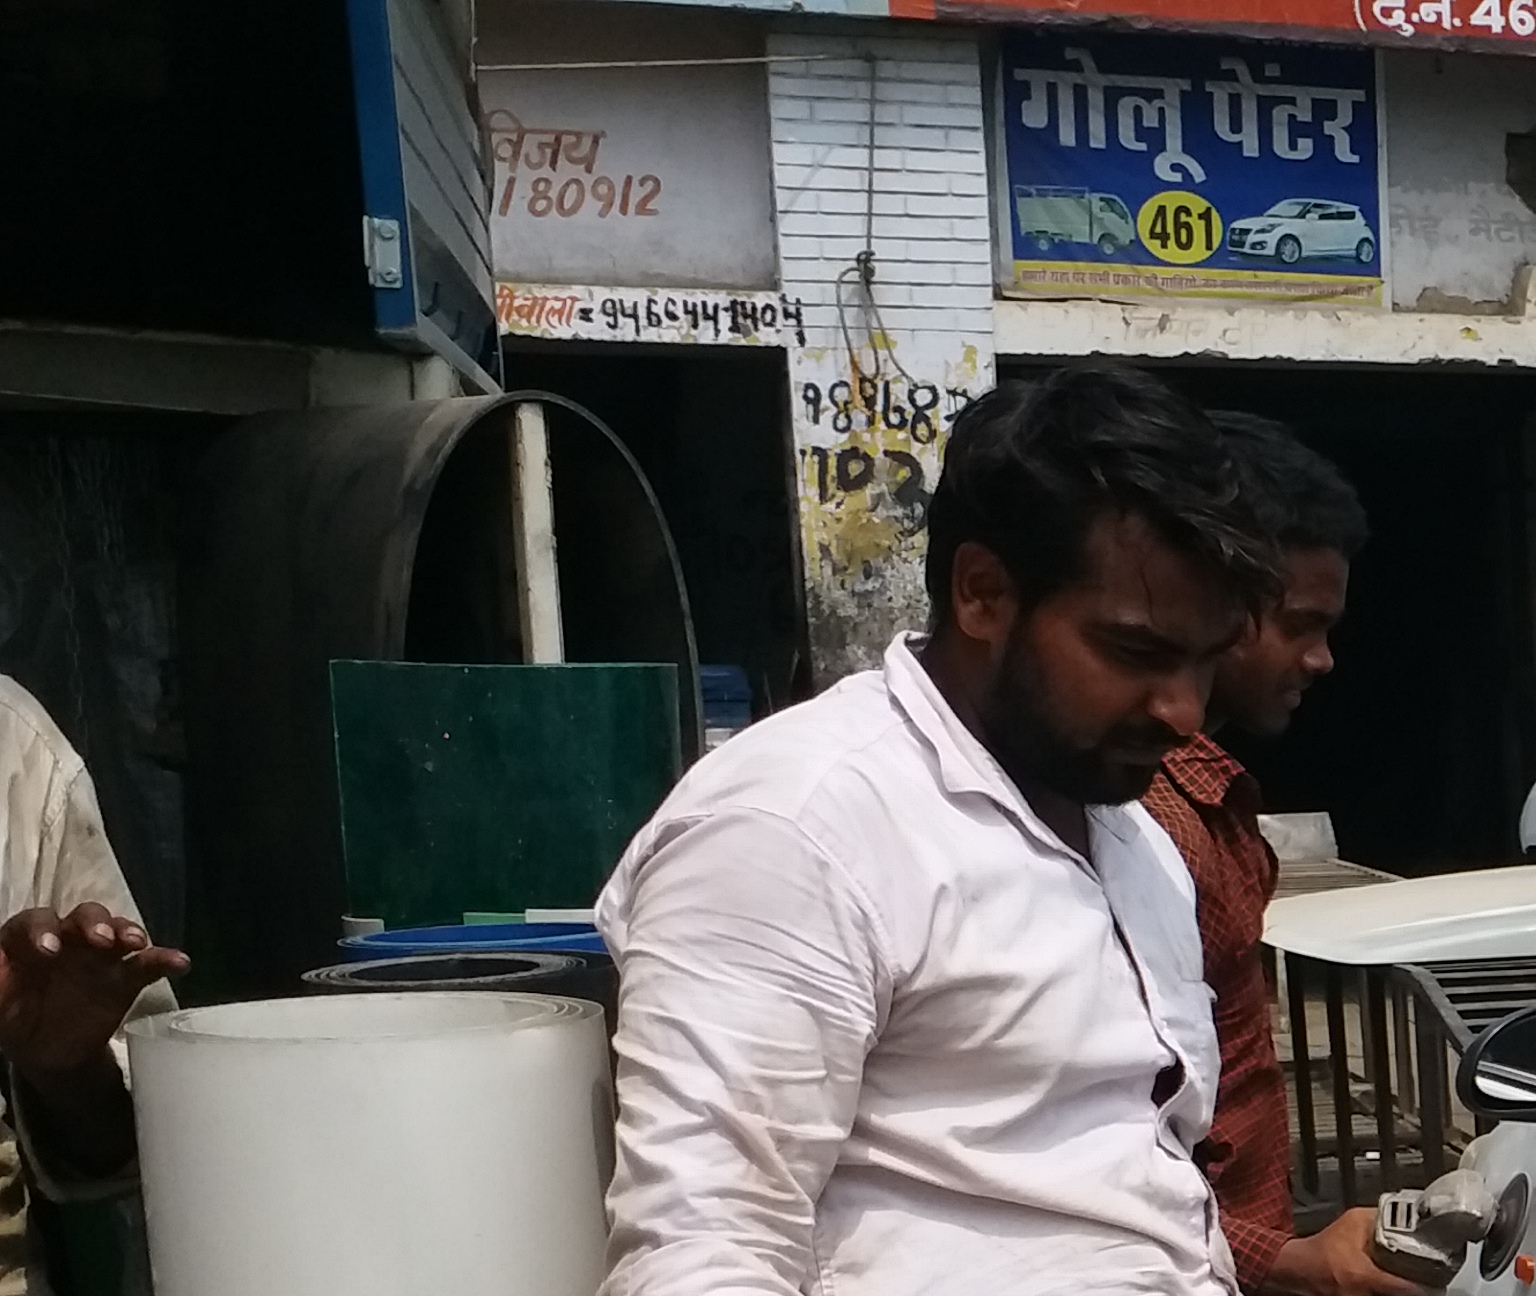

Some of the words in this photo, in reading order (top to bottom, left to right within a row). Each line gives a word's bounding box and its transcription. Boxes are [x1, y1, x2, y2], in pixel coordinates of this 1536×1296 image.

[484, 109, 606, 174] विजय
[1013, 46, 1208, 183] गोलू
[1206, 56, 1366, 164] पेंटर
[1148, 204, 1214, 252] 461
